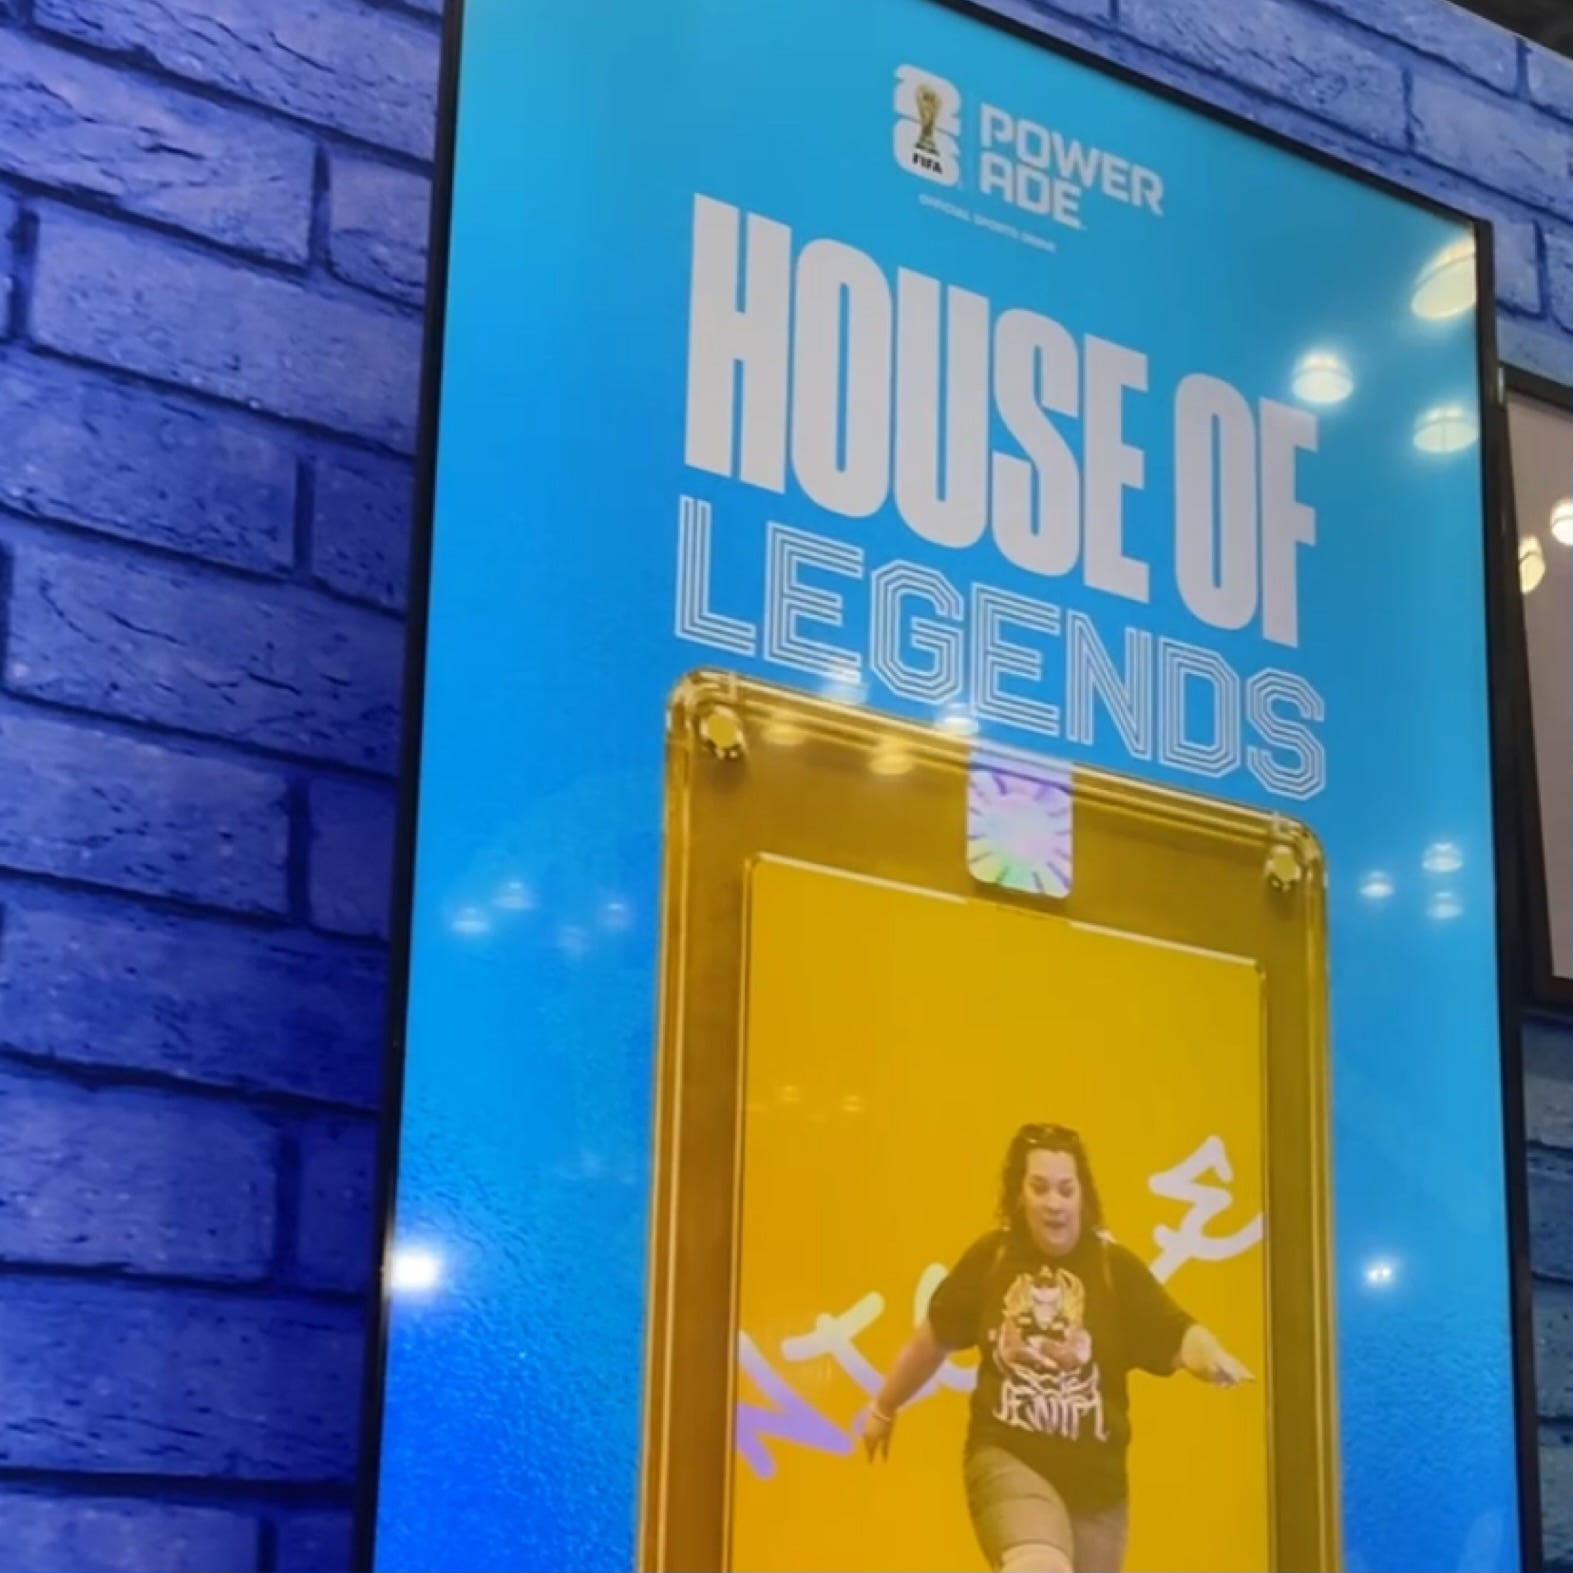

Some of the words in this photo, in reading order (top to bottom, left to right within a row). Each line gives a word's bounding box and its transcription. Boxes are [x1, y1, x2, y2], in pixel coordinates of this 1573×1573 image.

[911, 152, 944, 175] FIFA
[979, 151, 1082, 230] ADE
[980, 102, 1164, 217] POWER
[683, 191, 1150, 605] HOUSE
[1173, 371, 1319, 648] OF
[673, 494, 1328, 802] LEGENDS
